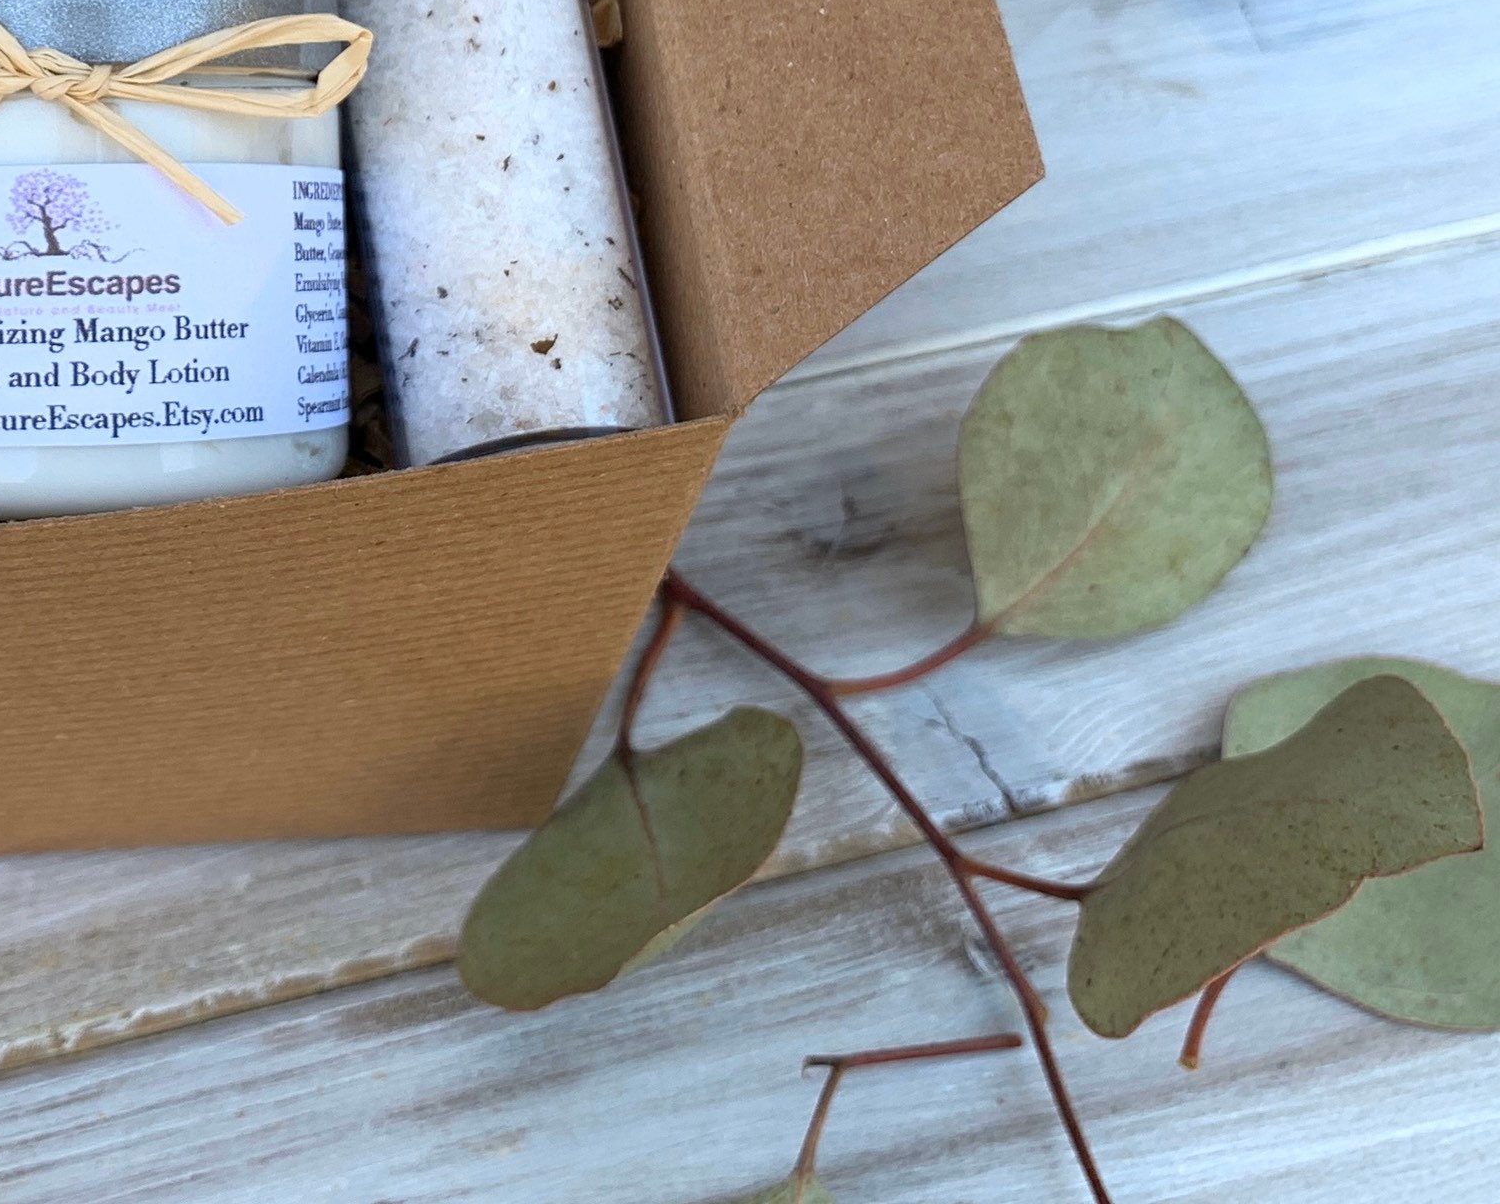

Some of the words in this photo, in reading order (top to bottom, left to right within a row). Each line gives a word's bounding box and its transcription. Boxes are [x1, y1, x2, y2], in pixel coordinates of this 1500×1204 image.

[293, 211, 325, 237] Mango
[294, 242, 327, 264] Butter,
[73, 316, 166, 351] Mango
[173, 315, 249, 341] Butter
[296, 332, 333, 353] Vitamin
[8, 362, 59, 388] and
[69, 360, 141, 393] Body
[147, 359, 230, 386] Lotion
